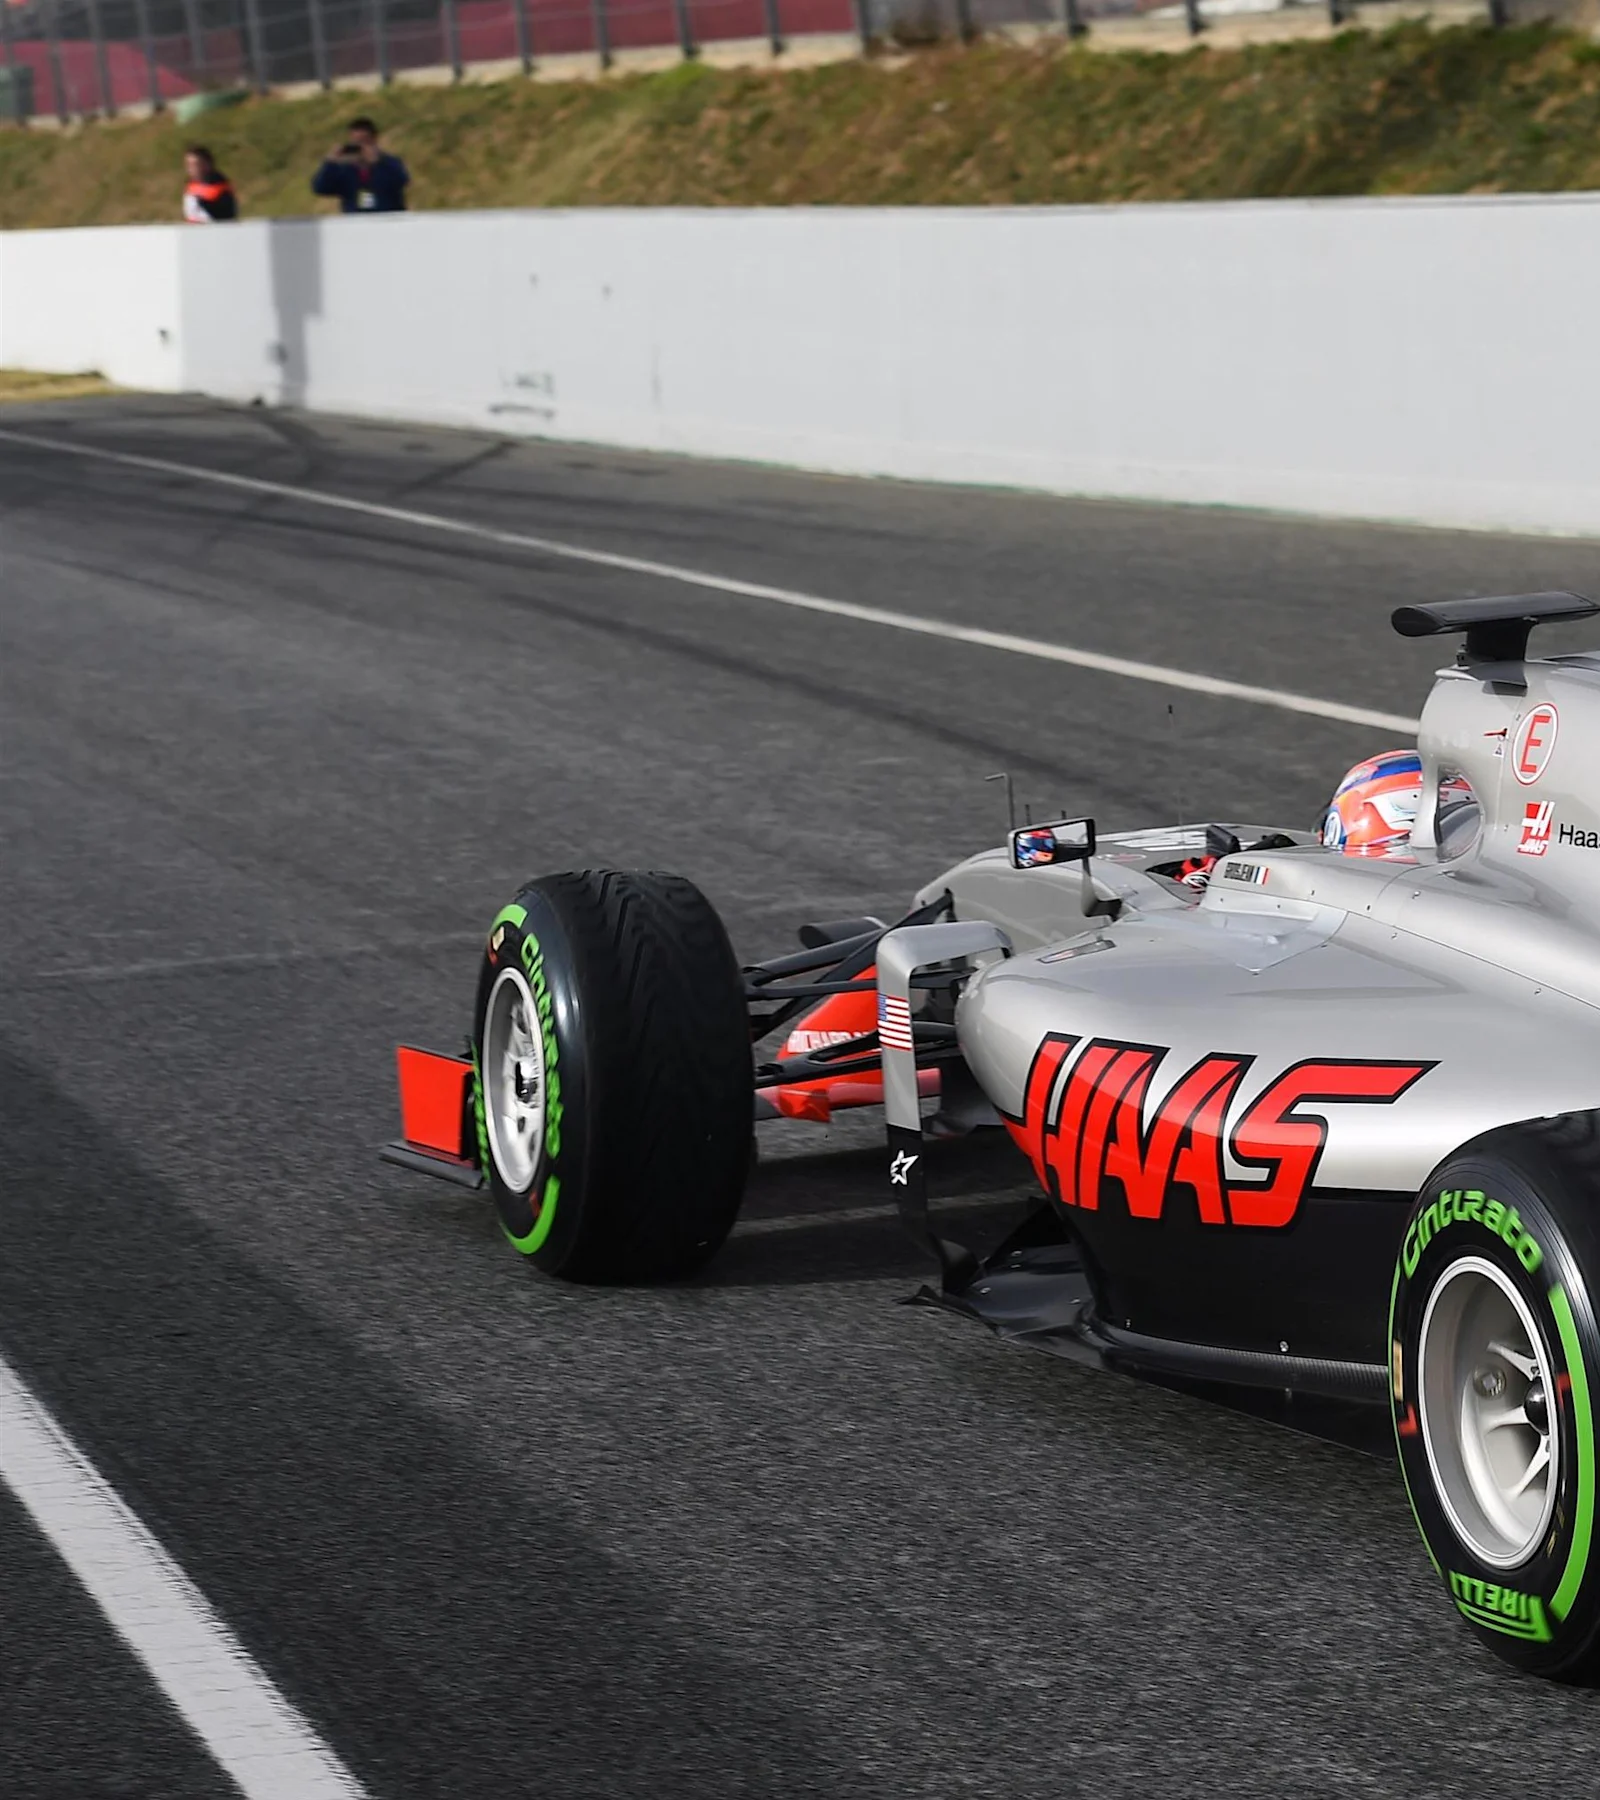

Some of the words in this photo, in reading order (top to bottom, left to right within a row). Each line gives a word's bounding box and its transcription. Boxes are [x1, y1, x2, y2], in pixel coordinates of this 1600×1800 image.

[1520, 714, 1552, 773] E
[1002, 1031, 1442, 1233] HAAS
[1448, 1568, 1553, 1643] PIRELLI
